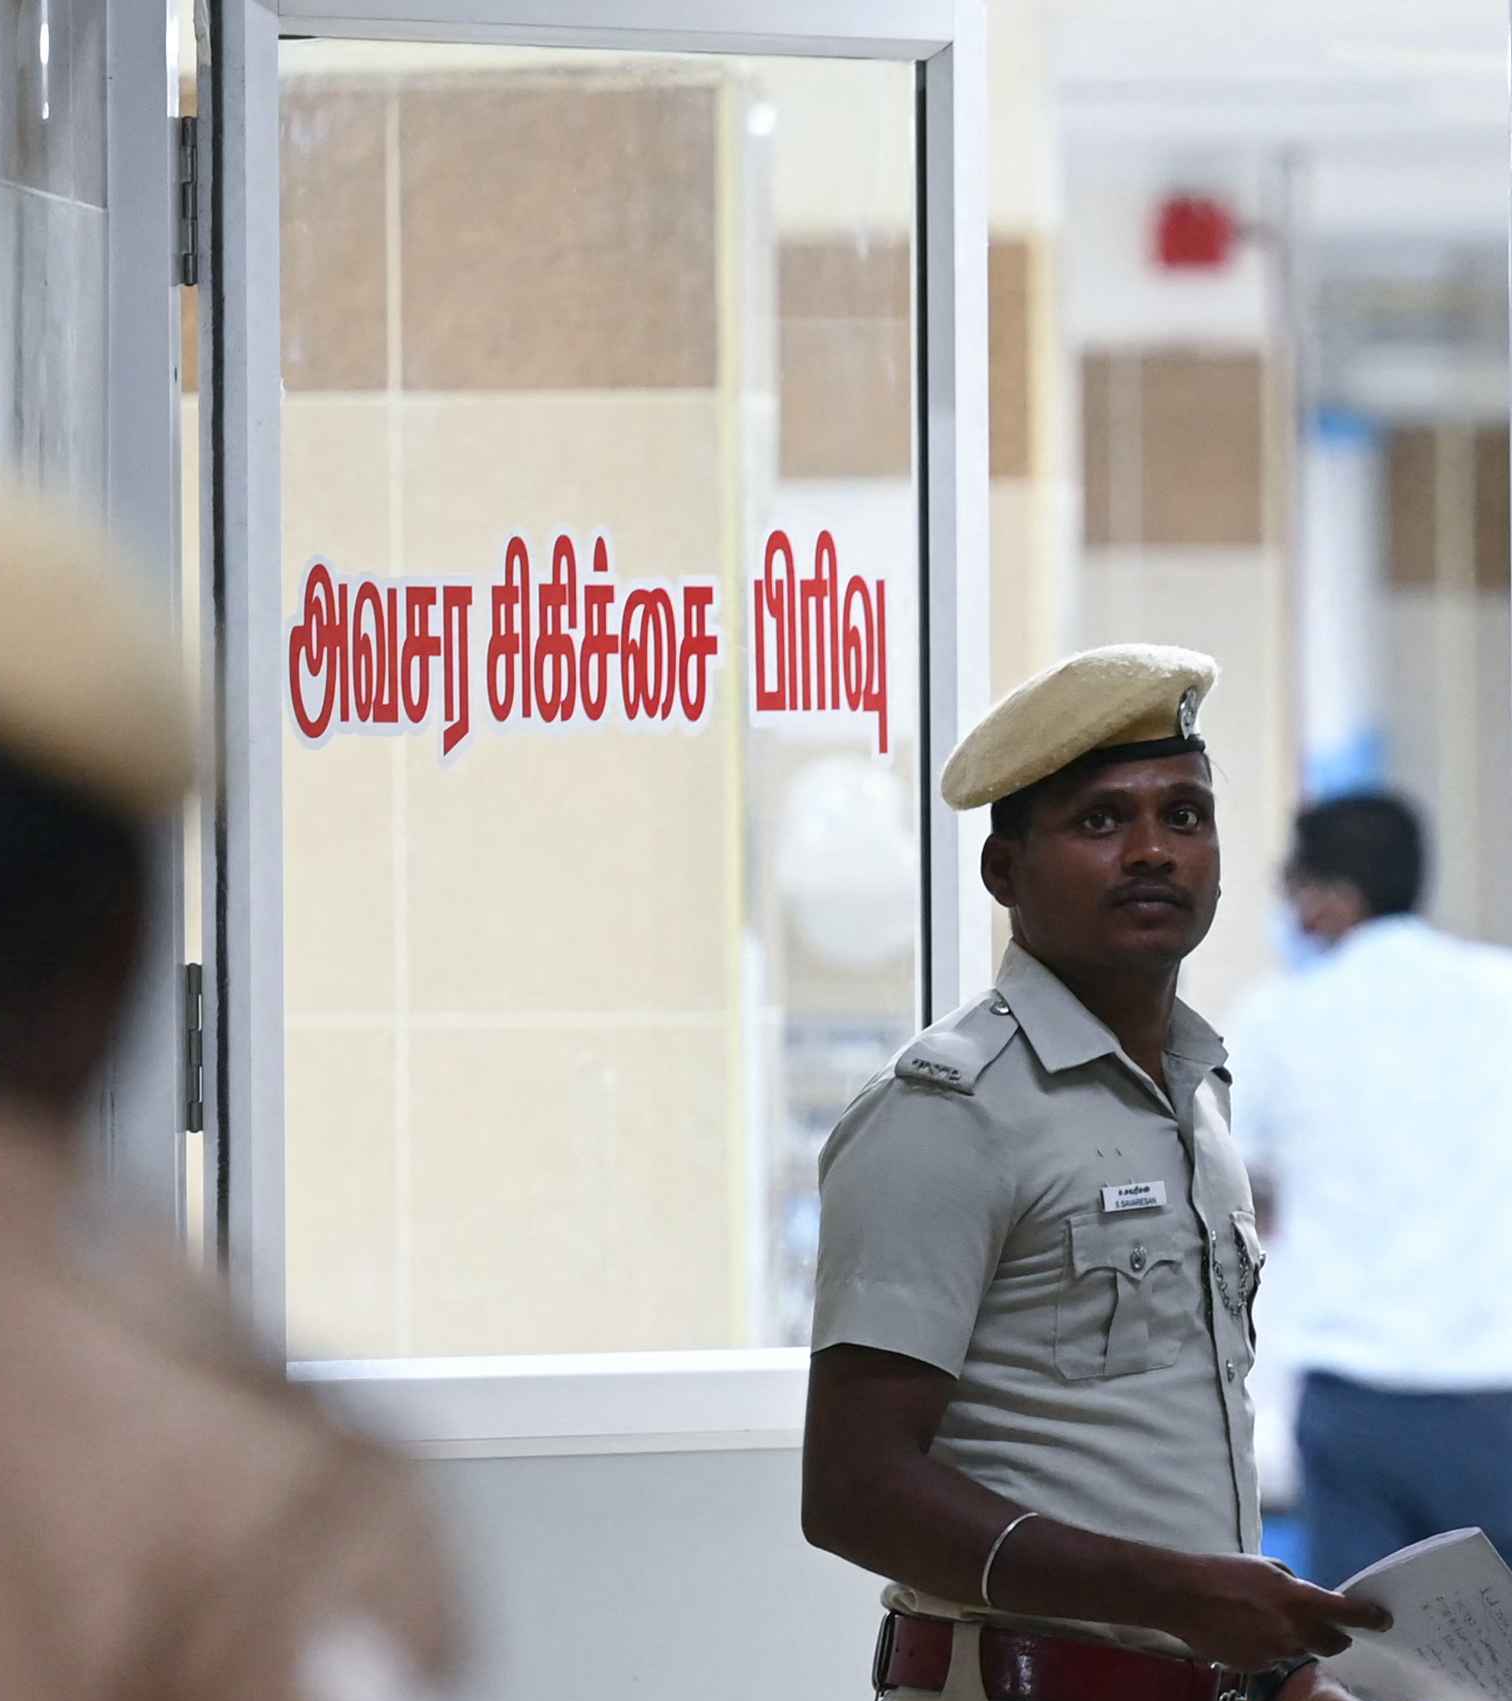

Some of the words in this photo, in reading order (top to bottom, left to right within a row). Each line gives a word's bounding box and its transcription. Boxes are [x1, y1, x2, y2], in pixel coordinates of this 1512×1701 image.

[288, 563, 473, 757] அவசர
[487, 534, 719, 723] சிகிச்சை
[753, 529, 890, 754] பிரிவு
